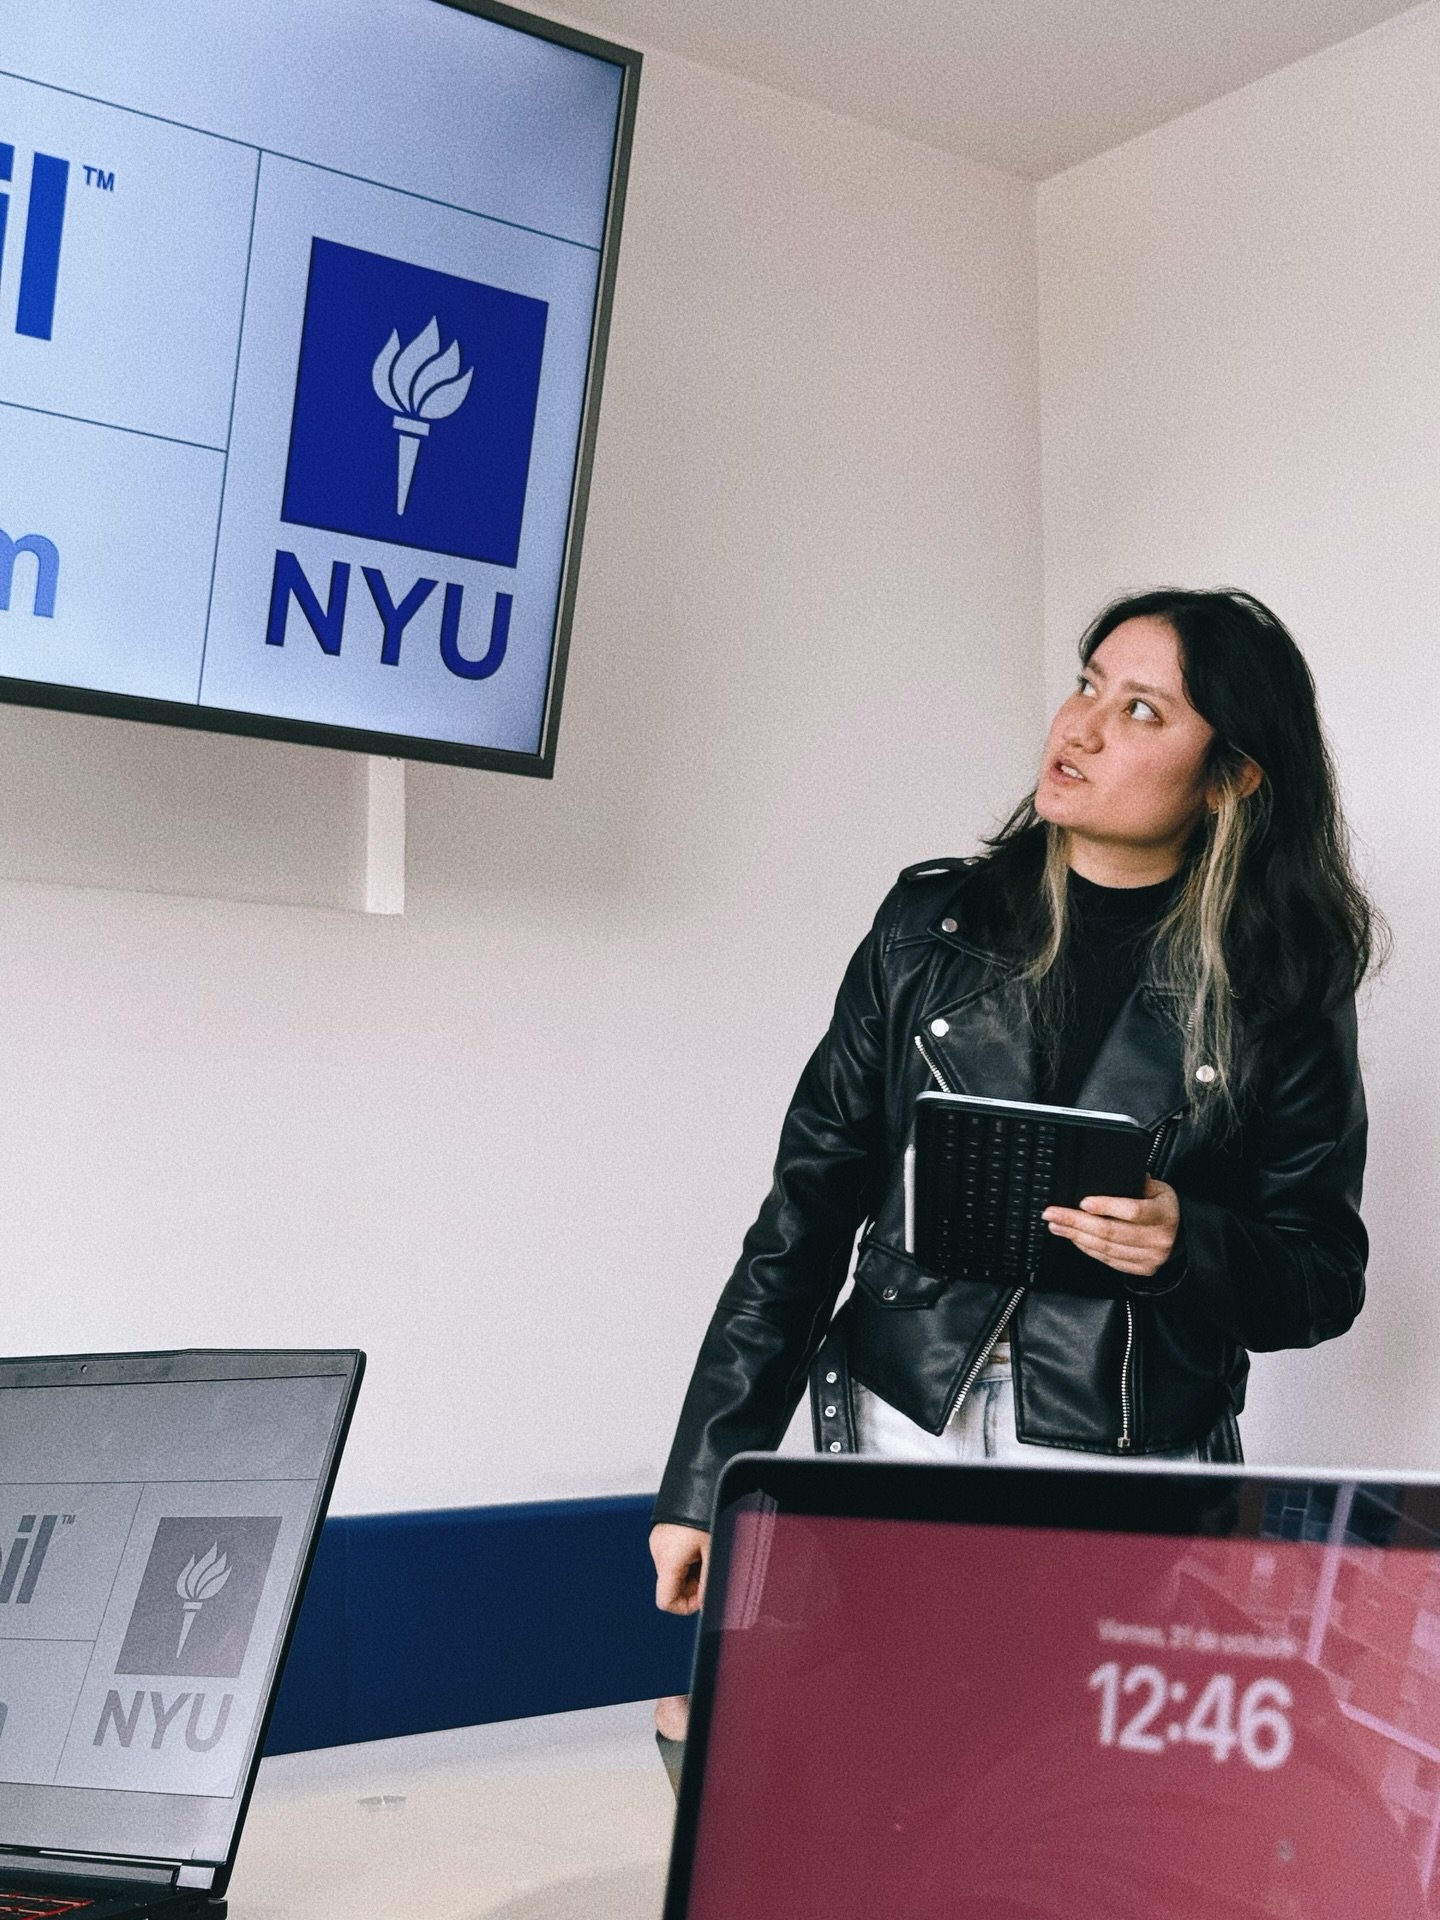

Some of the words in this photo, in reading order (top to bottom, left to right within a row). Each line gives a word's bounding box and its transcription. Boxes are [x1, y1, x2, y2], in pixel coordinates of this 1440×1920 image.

[266, 549, 513, 680] NYU
[0, 1514, 59, 1604] il
[93, 1689, 234, 1752] NYU
[1089, 1661, 1294, 1771] 12:46
